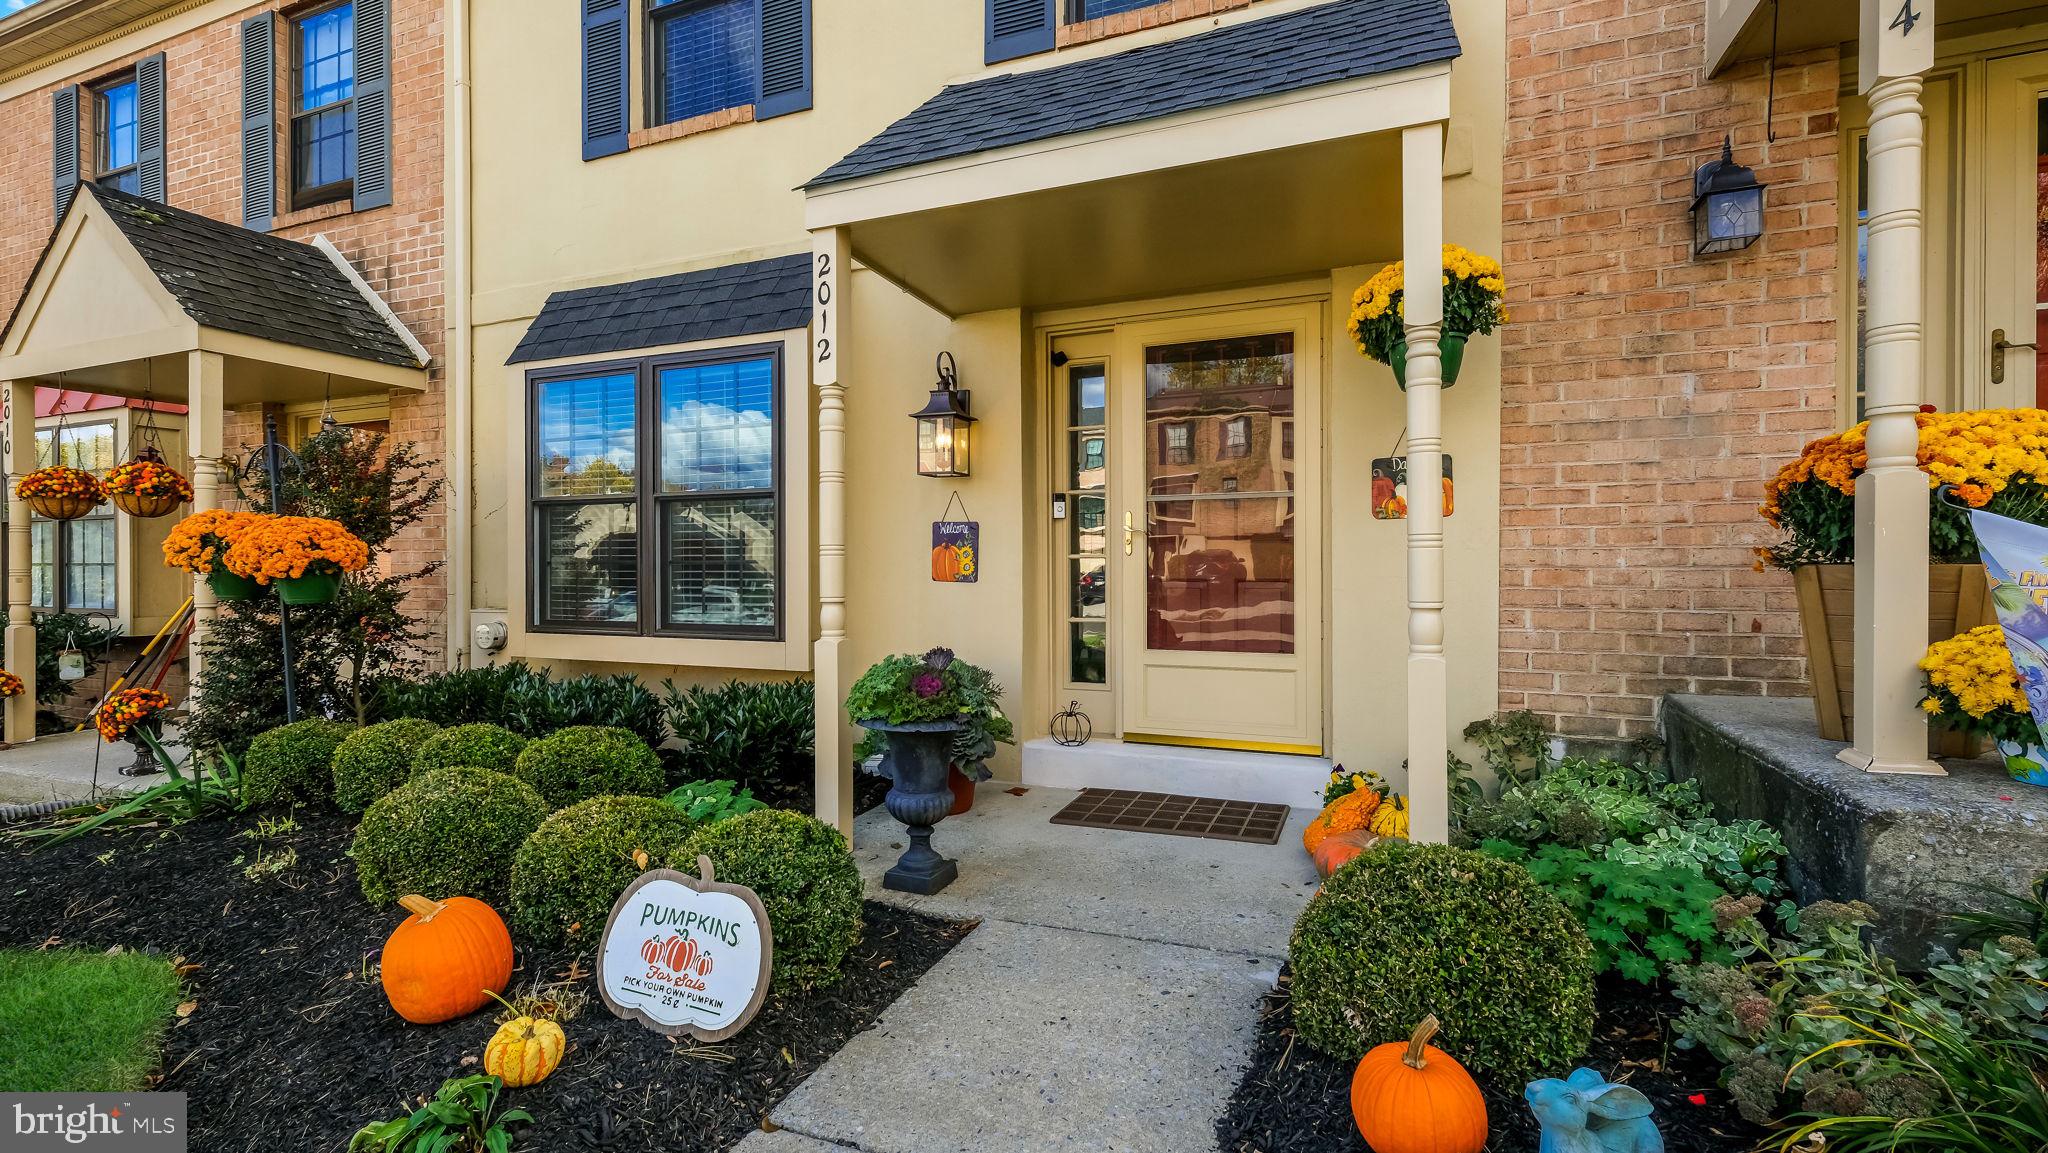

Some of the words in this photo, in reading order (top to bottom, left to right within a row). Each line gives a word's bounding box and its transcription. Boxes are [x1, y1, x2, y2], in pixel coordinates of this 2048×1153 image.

[1888, 0, 1921, 37] 4
[817, 253, 831, 364] 2012
[3, 388, 11, 455] 2010
[939, 522, 970, 535] Welcome
[639, 902, 741, 947] PUMPKINS
[623, 975, 642, 987] PICK
[643, 980, 665, 993] YOUR
[666, 987, 686, 998] OWN
[686, 992, 723, 1008] PUMPKIN
[645, 965, 673, 983] For
[673, 973, 706, 991] Sale
